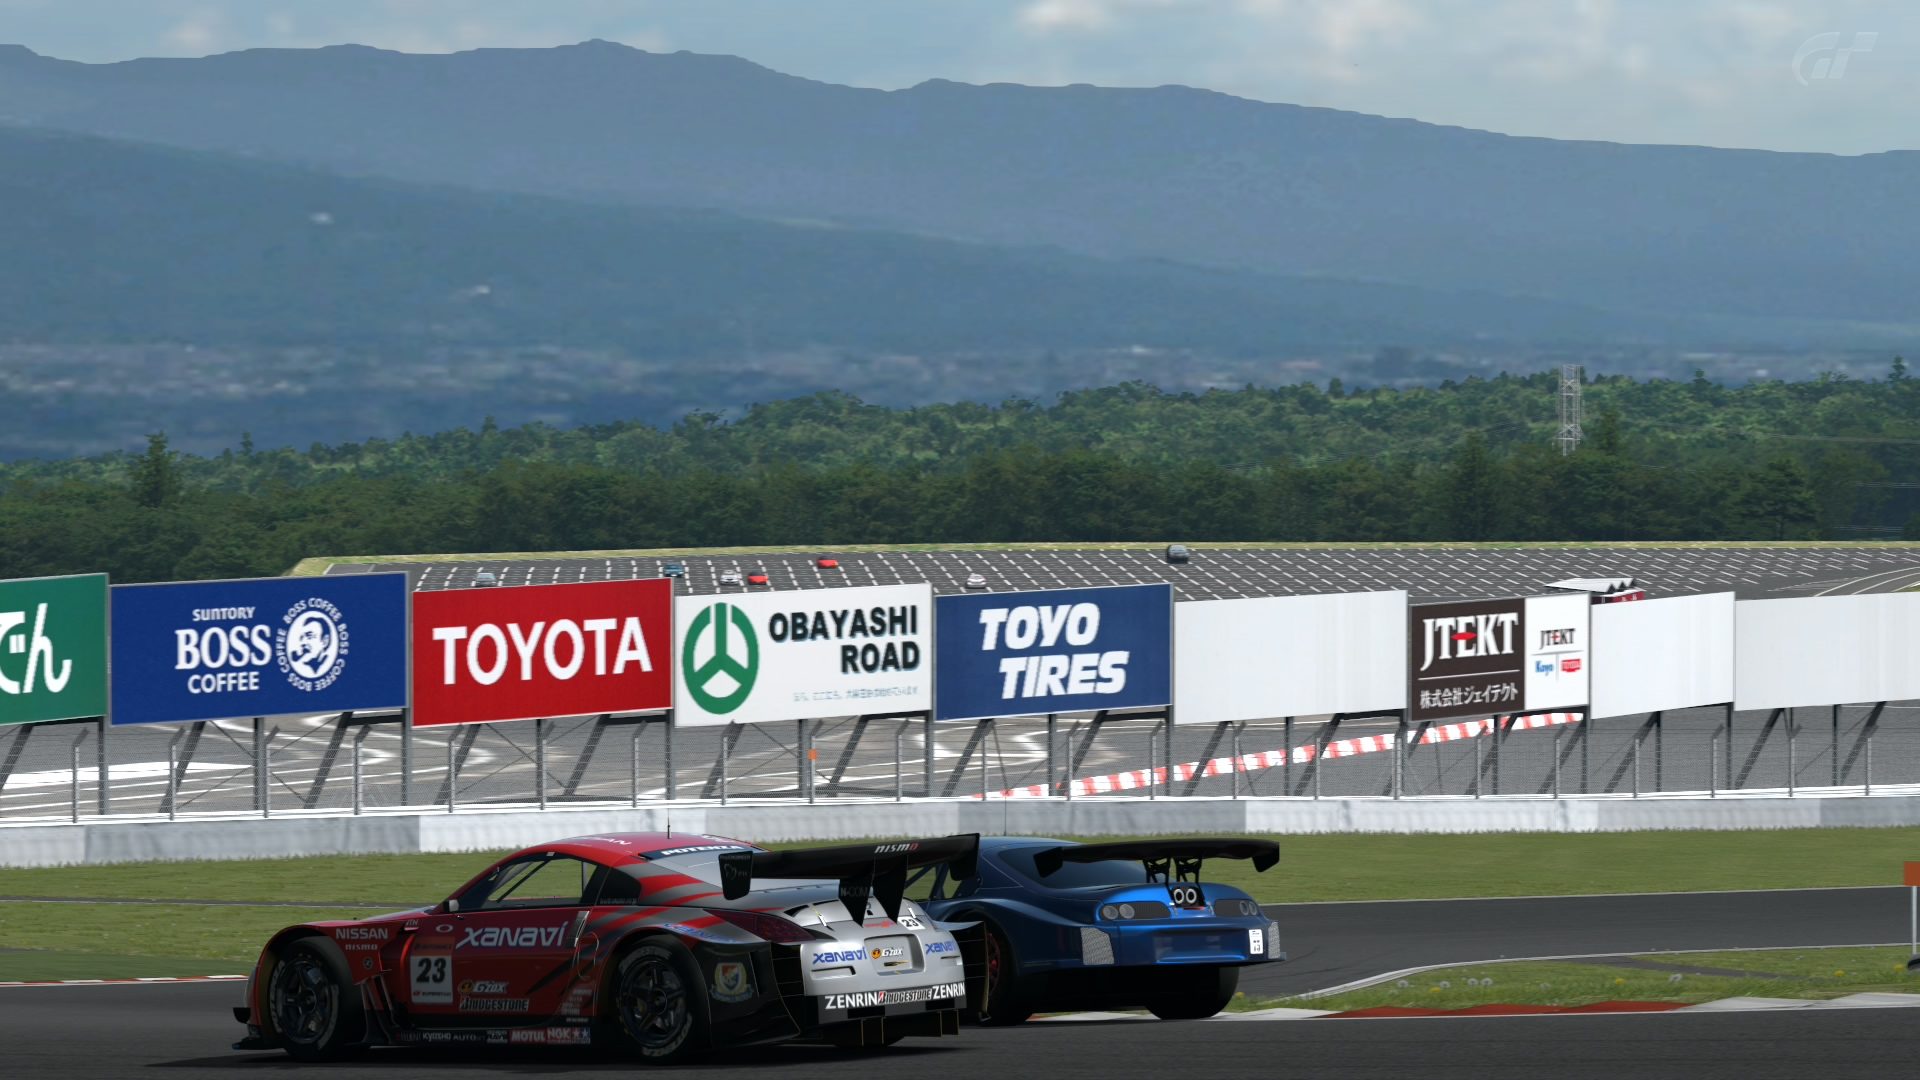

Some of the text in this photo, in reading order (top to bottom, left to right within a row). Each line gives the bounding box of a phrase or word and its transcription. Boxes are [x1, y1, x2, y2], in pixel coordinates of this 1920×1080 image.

[192, 606, 256, 621] SUNTORY
[769, 604, 918, 642] OBAYASHI
[979, 602, 1101, 651] TOYO
[175, 624, 273, 670] BOSS
[432, 615, 654, 686] TOYOTA
[1420, 612, 1519, 672] JTEKT
[1539, 628, 1576, 650] JTEKT
[841, 641, 920, 674] ROAD
[187, 671, 260, 694] COFFEE
[999, 650, 1130, 699] TIRES
[1420, 682, 1519, 709] 株式会社ジェイテクト
[335, 927, 389, 940] NISSAN
[416, 957, 447, 983] 23
[825, 988, 933, 1010] ZENRIN BRIDGESTONE
[932, 982, 966, 999] ZENRIN
[461, 998, 529, 1011] BRIDGESTONE
[511, 1030, 546, 1043] MOTUL
